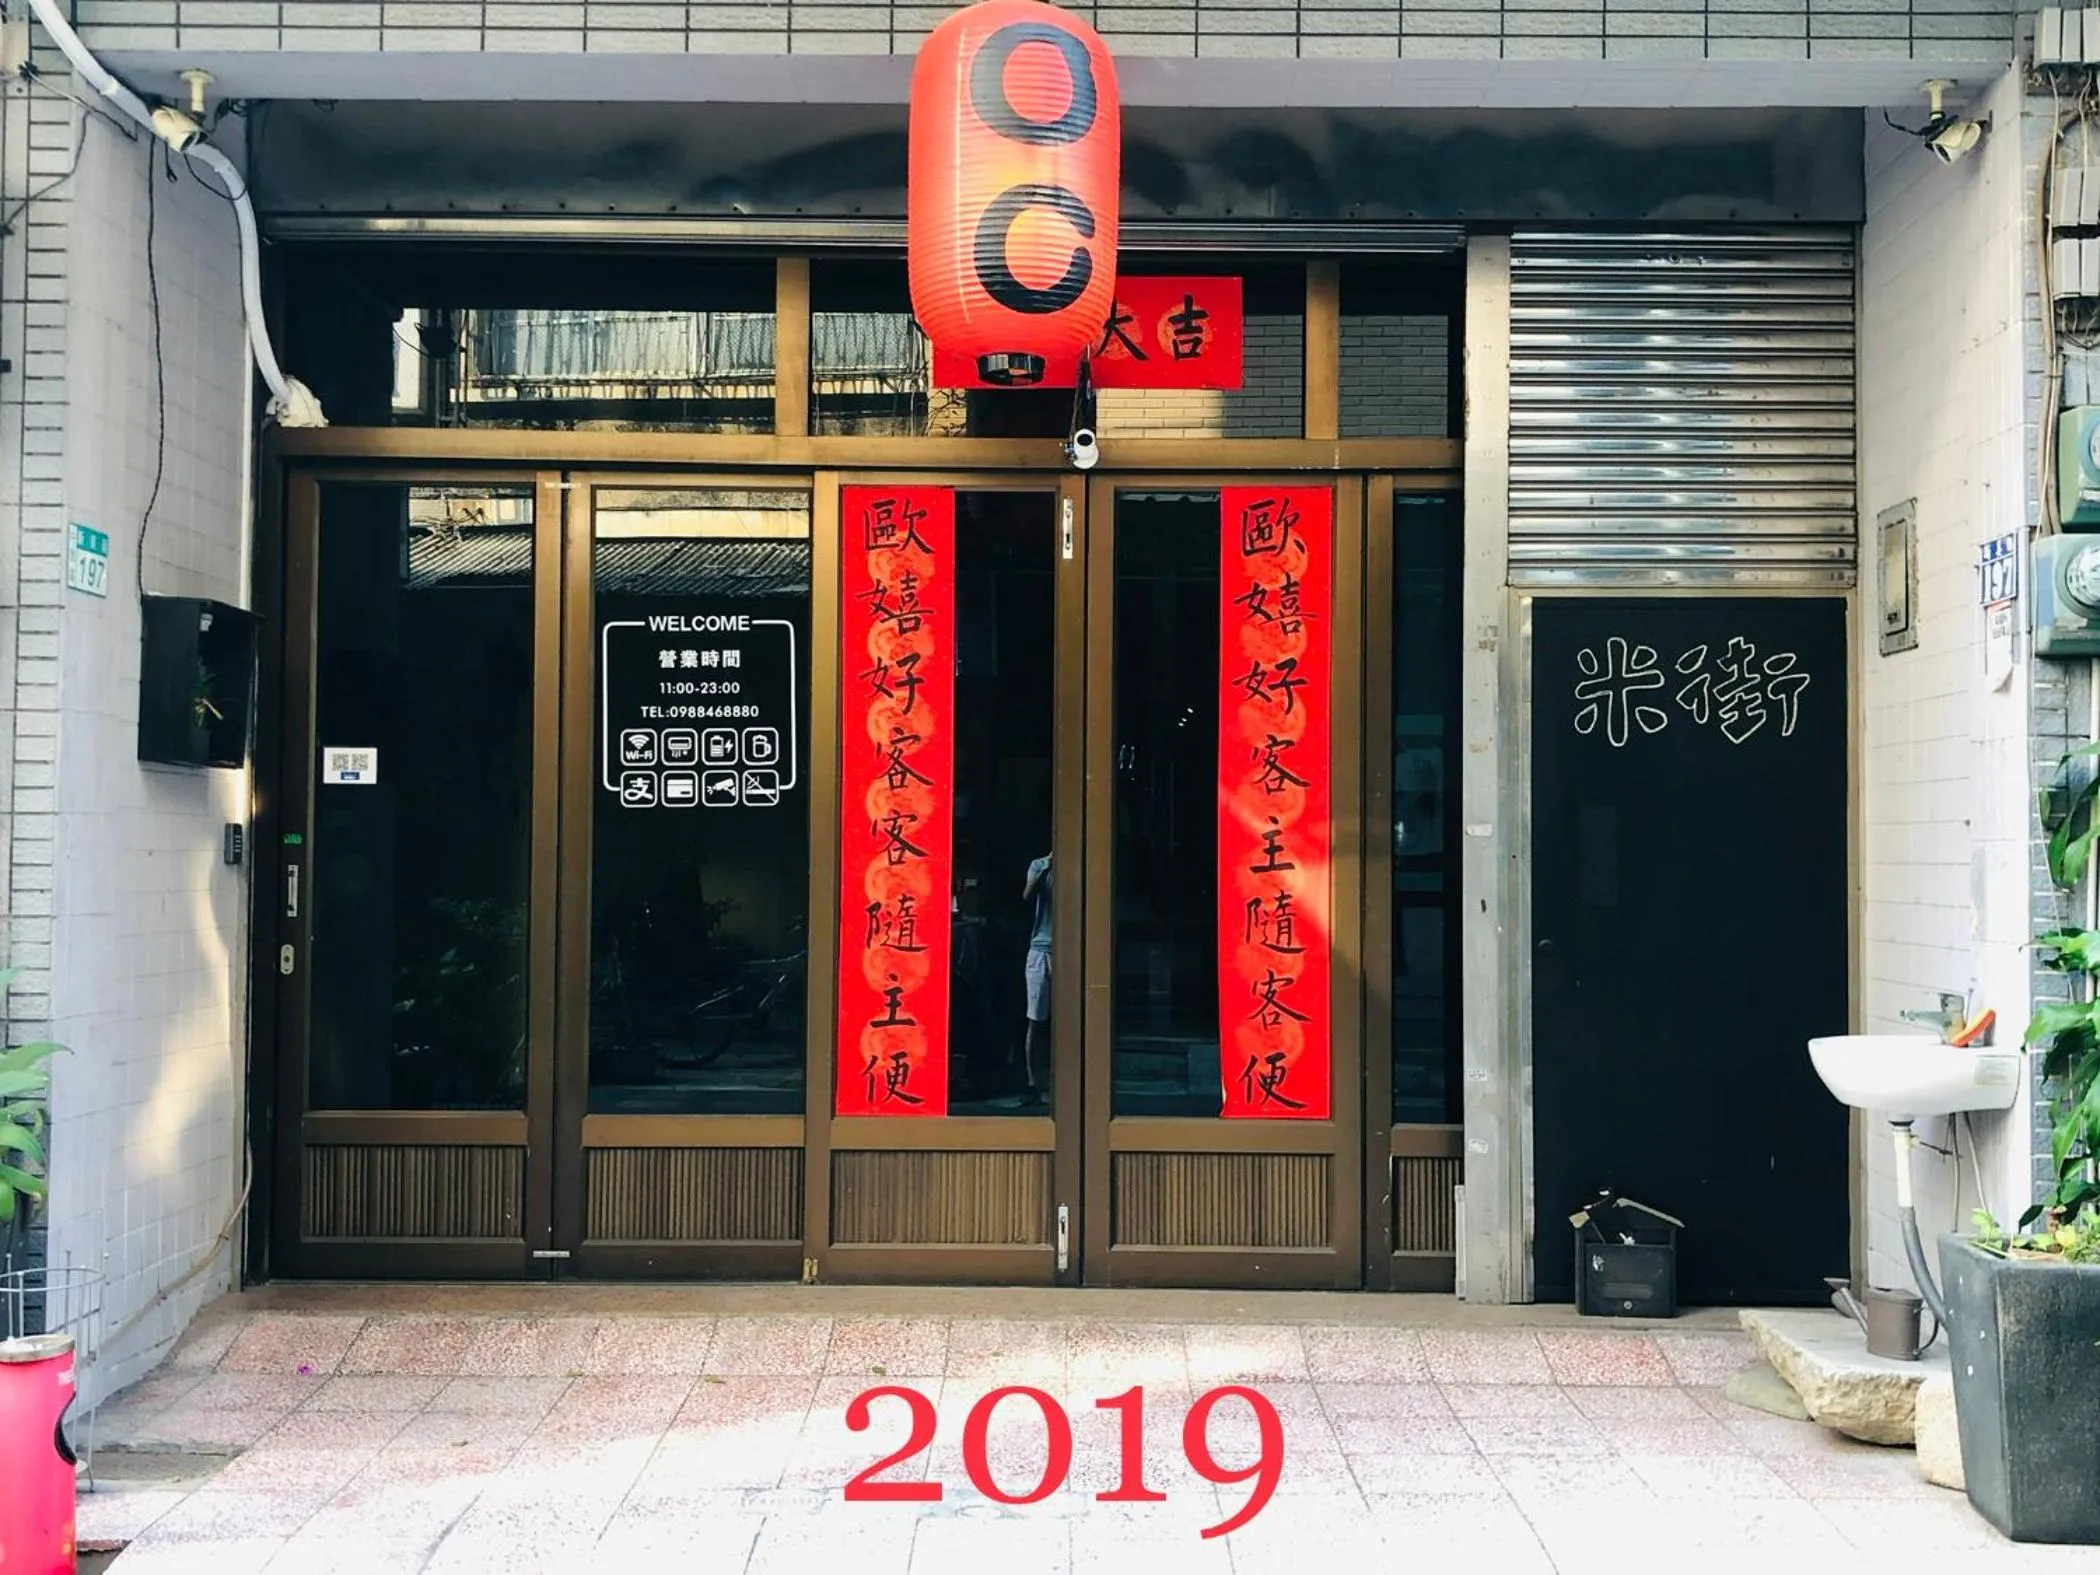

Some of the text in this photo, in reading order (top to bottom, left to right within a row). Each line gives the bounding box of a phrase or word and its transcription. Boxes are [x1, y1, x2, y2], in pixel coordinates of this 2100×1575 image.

[79, 556, 105, 588] 197
[1983, 556, 2013, 603] 197
[648, 615, 750, 632] WELCOME
[658, 650, 741, 669] 營業時間
[659, 681, 741, 695] 11:00-23:00
[1574, 636, 1811, 747] 米街
[640, 705, 760, 718] TEL:0988468880
[625, 751, 653, 761] Wi-Fi
